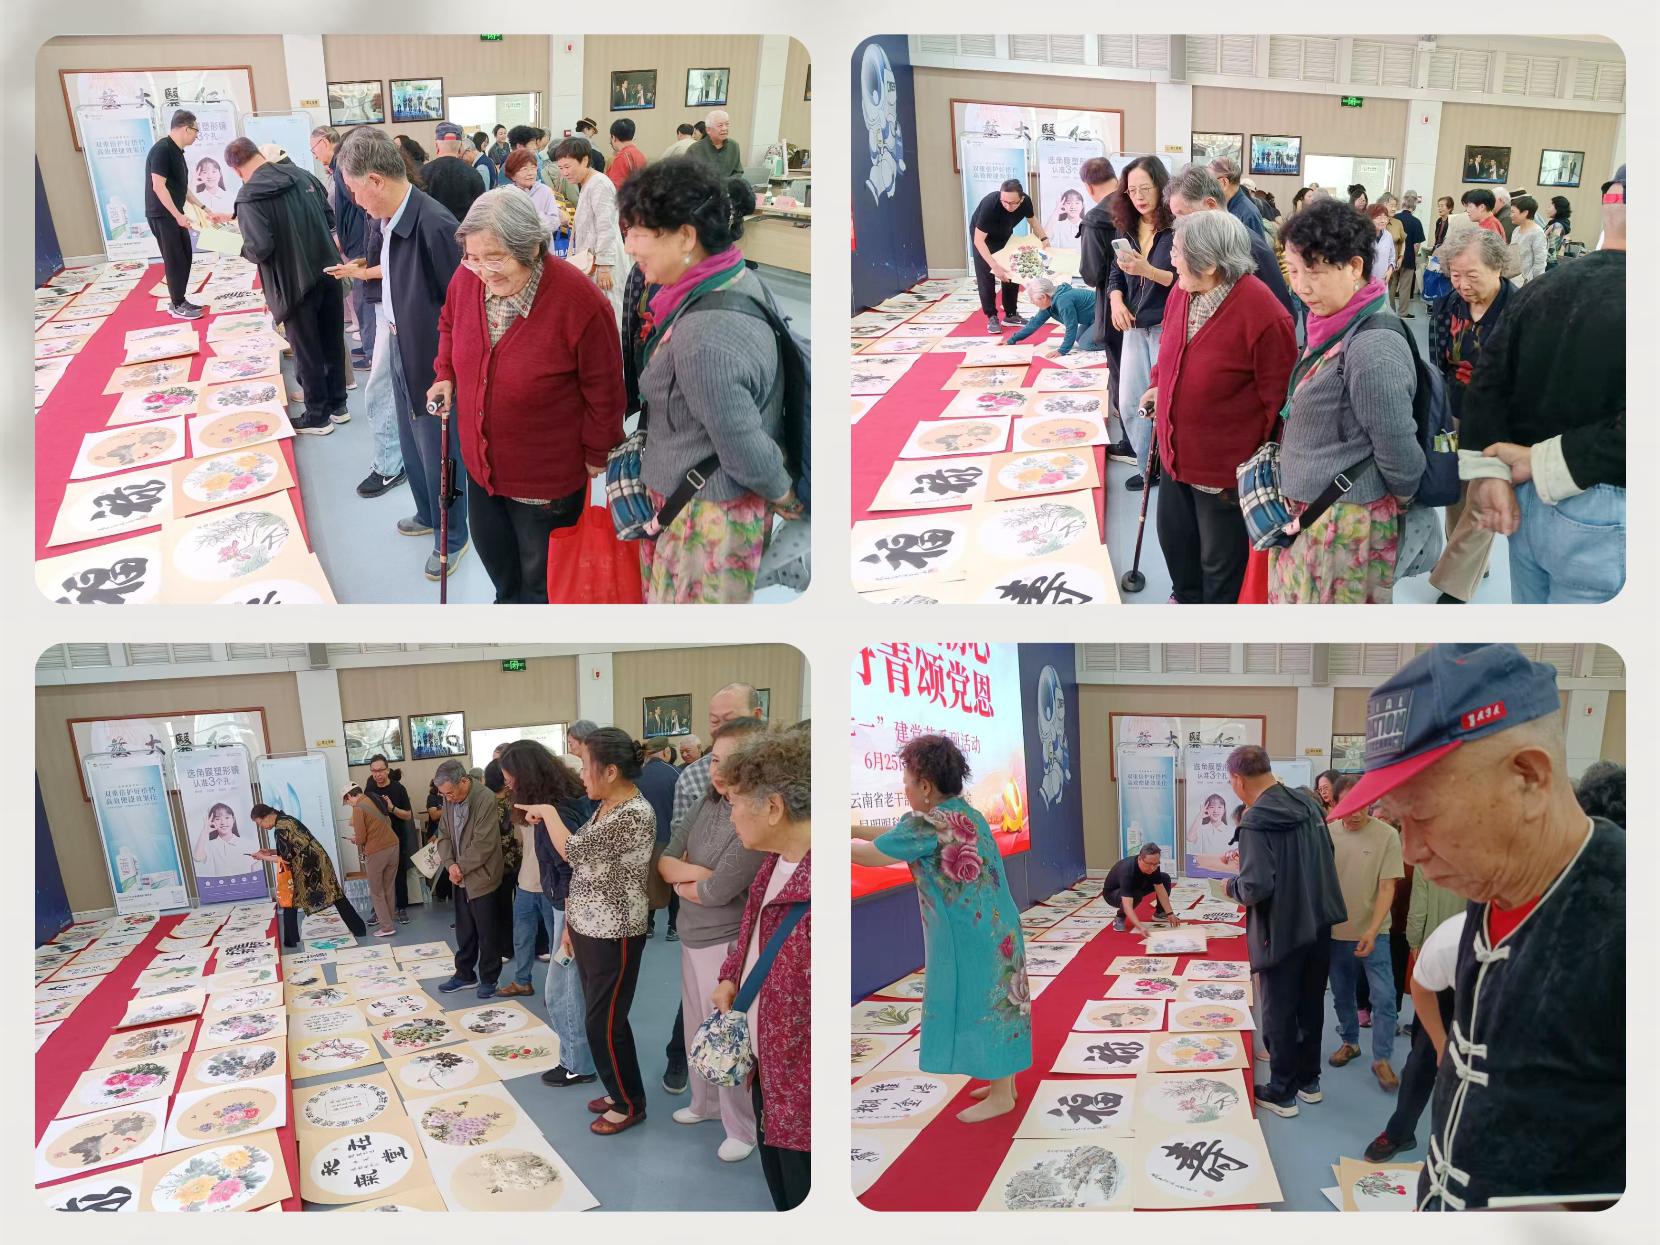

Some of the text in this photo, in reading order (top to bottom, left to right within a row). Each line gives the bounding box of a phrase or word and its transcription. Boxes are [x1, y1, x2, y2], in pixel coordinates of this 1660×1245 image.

[198, 121, 227, 131] 塑形镜
[1048, 156, 1085, 166] 选角膜塑
[1052, 165, 1081, 175] 认准3个
[187, 765, 240, 779] 选角膜塑形镜
[193, 776, 231, 788] 认准3个孔
